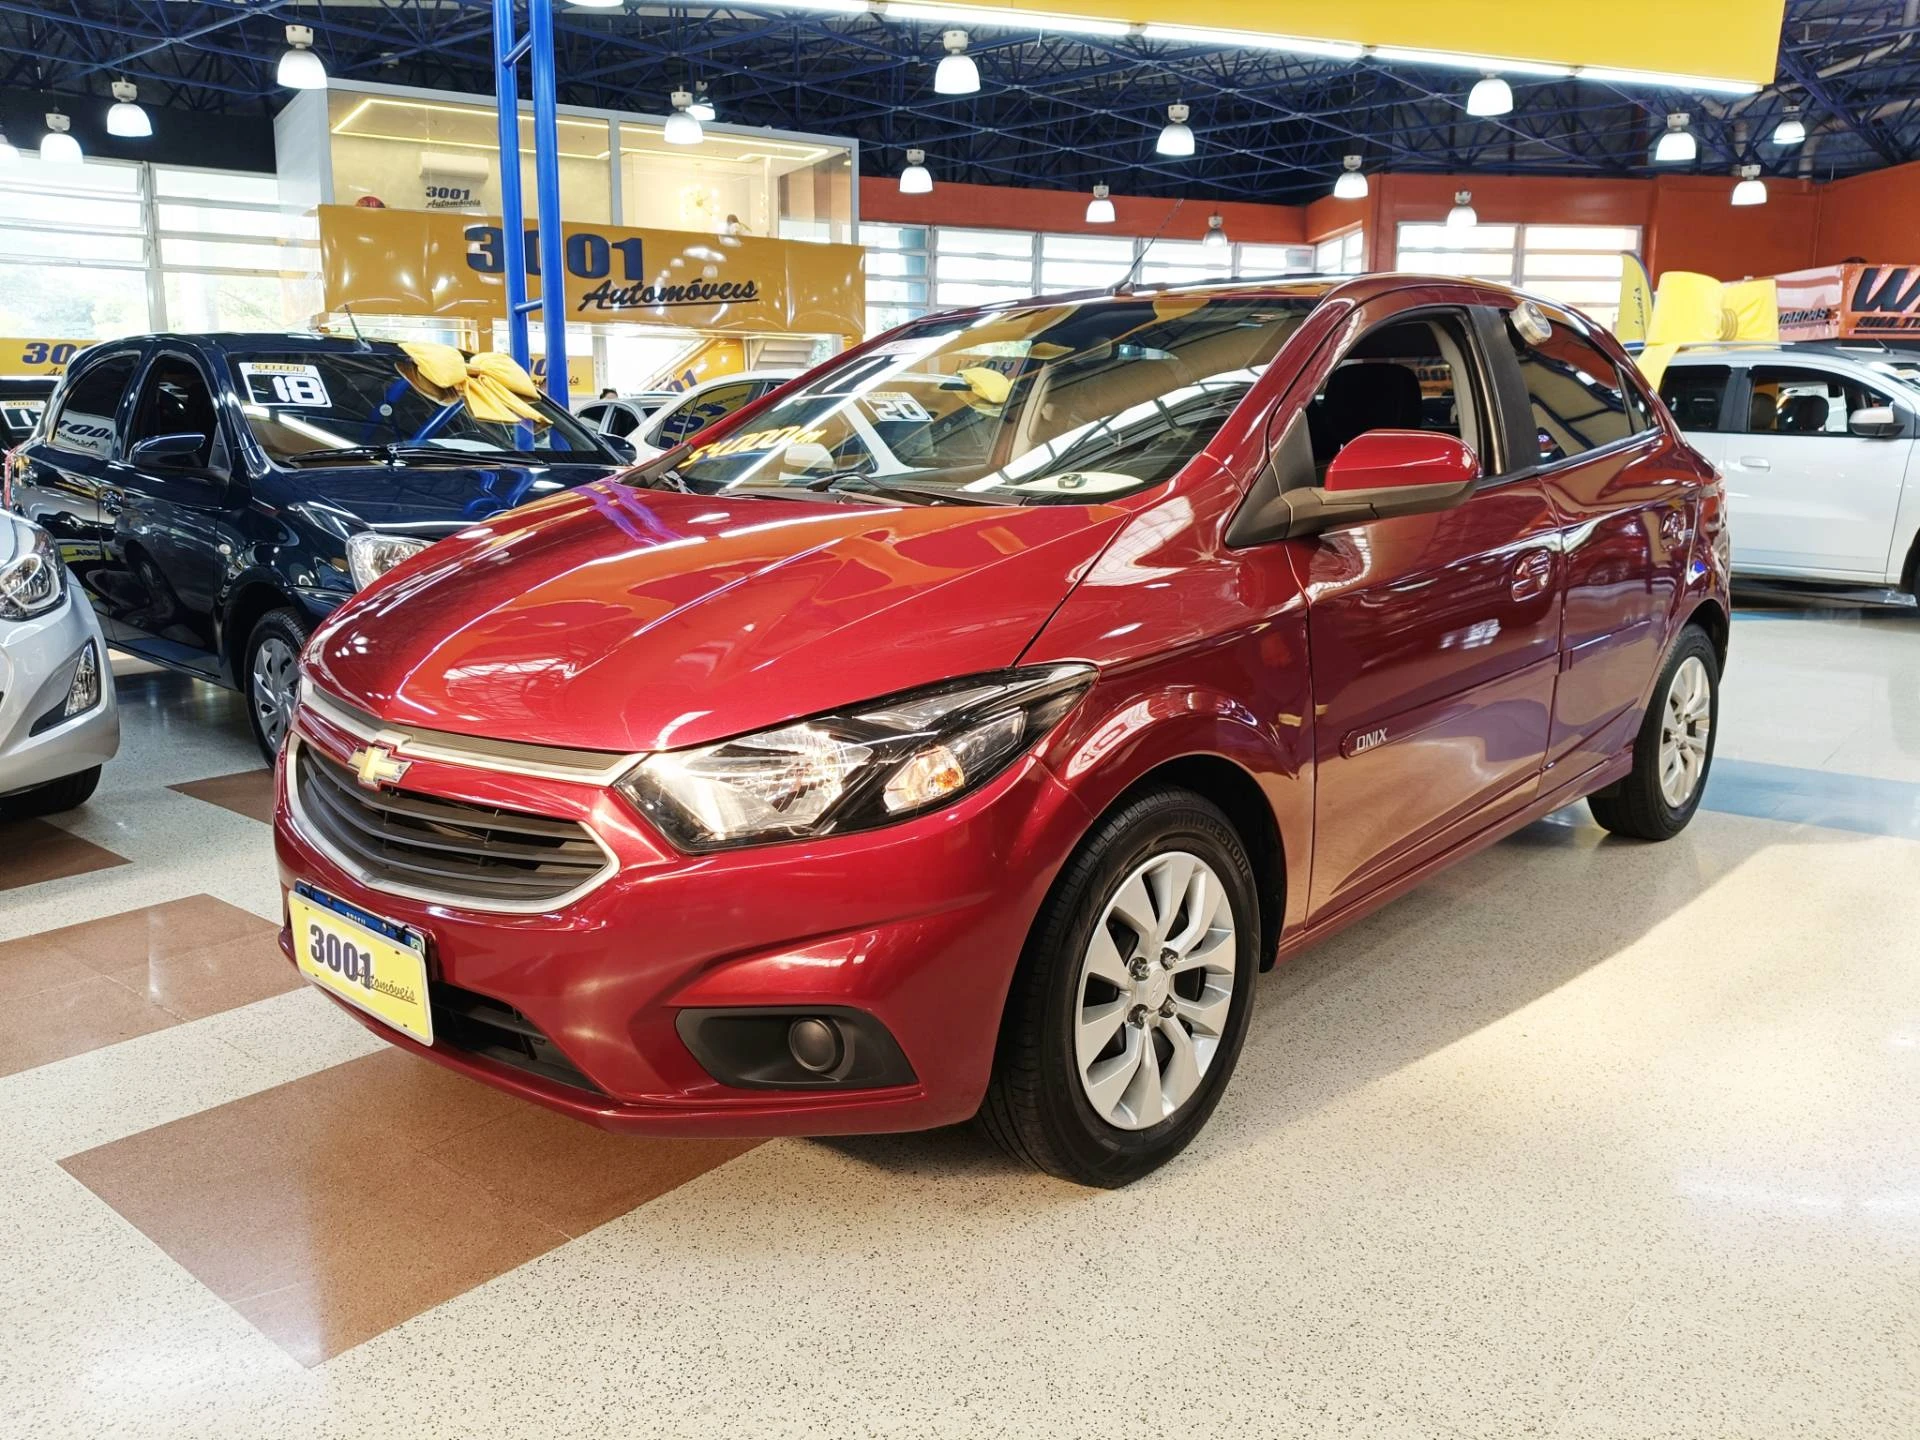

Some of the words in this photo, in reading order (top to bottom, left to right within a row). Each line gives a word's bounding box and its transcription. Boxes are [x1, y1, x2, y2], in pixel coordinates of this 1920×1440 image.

[425, 186, 470, 200] 3001
[1851, 267, 1920, 312] W
[22, 342, 96, 365] 30
[272, 375, 327, 405] 18
[872, 400, 932, 422] 20
[1356, 727, 1388, 751] ONIX
[310, 924, 371, 991] 3001
